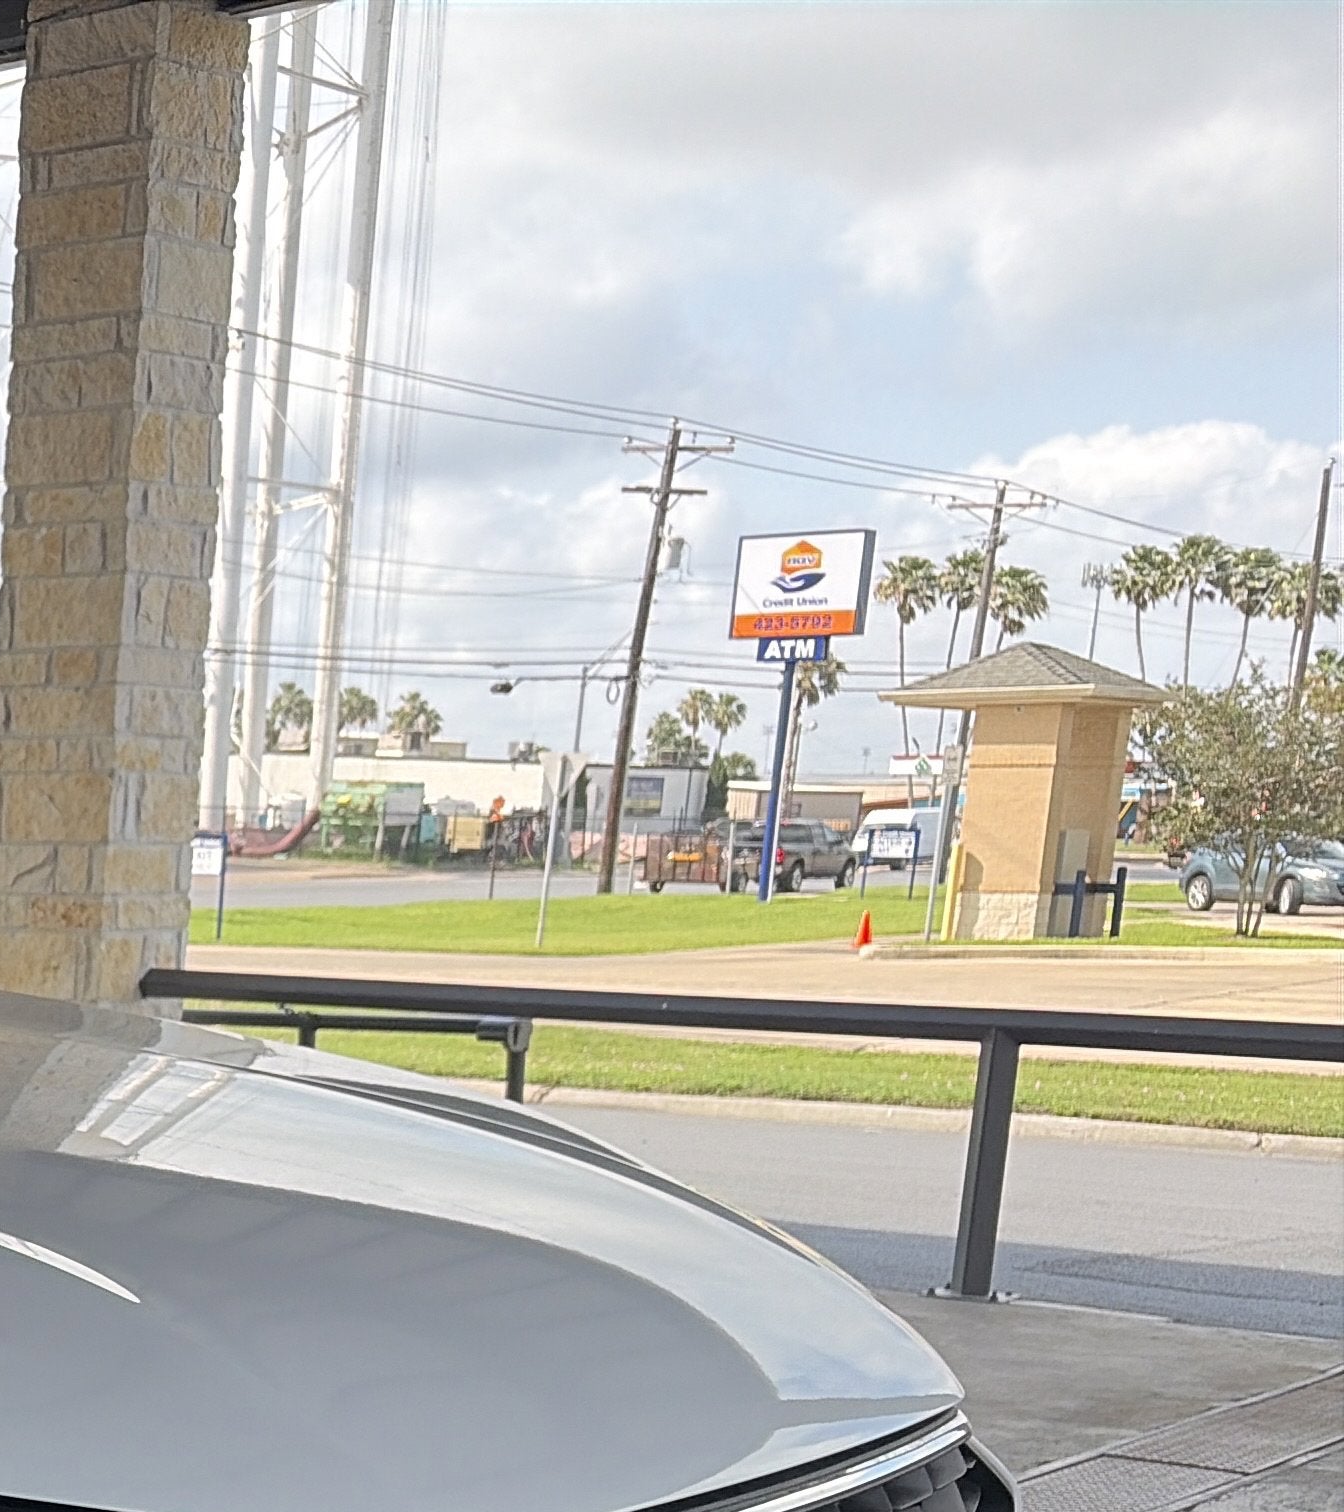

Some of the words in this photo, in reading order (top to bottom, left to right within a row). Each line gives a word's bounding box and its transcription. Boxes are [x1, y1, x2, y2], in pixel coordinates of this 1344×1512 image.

[762, 597, 794, 608] Credit
[796, 596, 828, 606] Union
[764, 639, 815, 659] ATM
